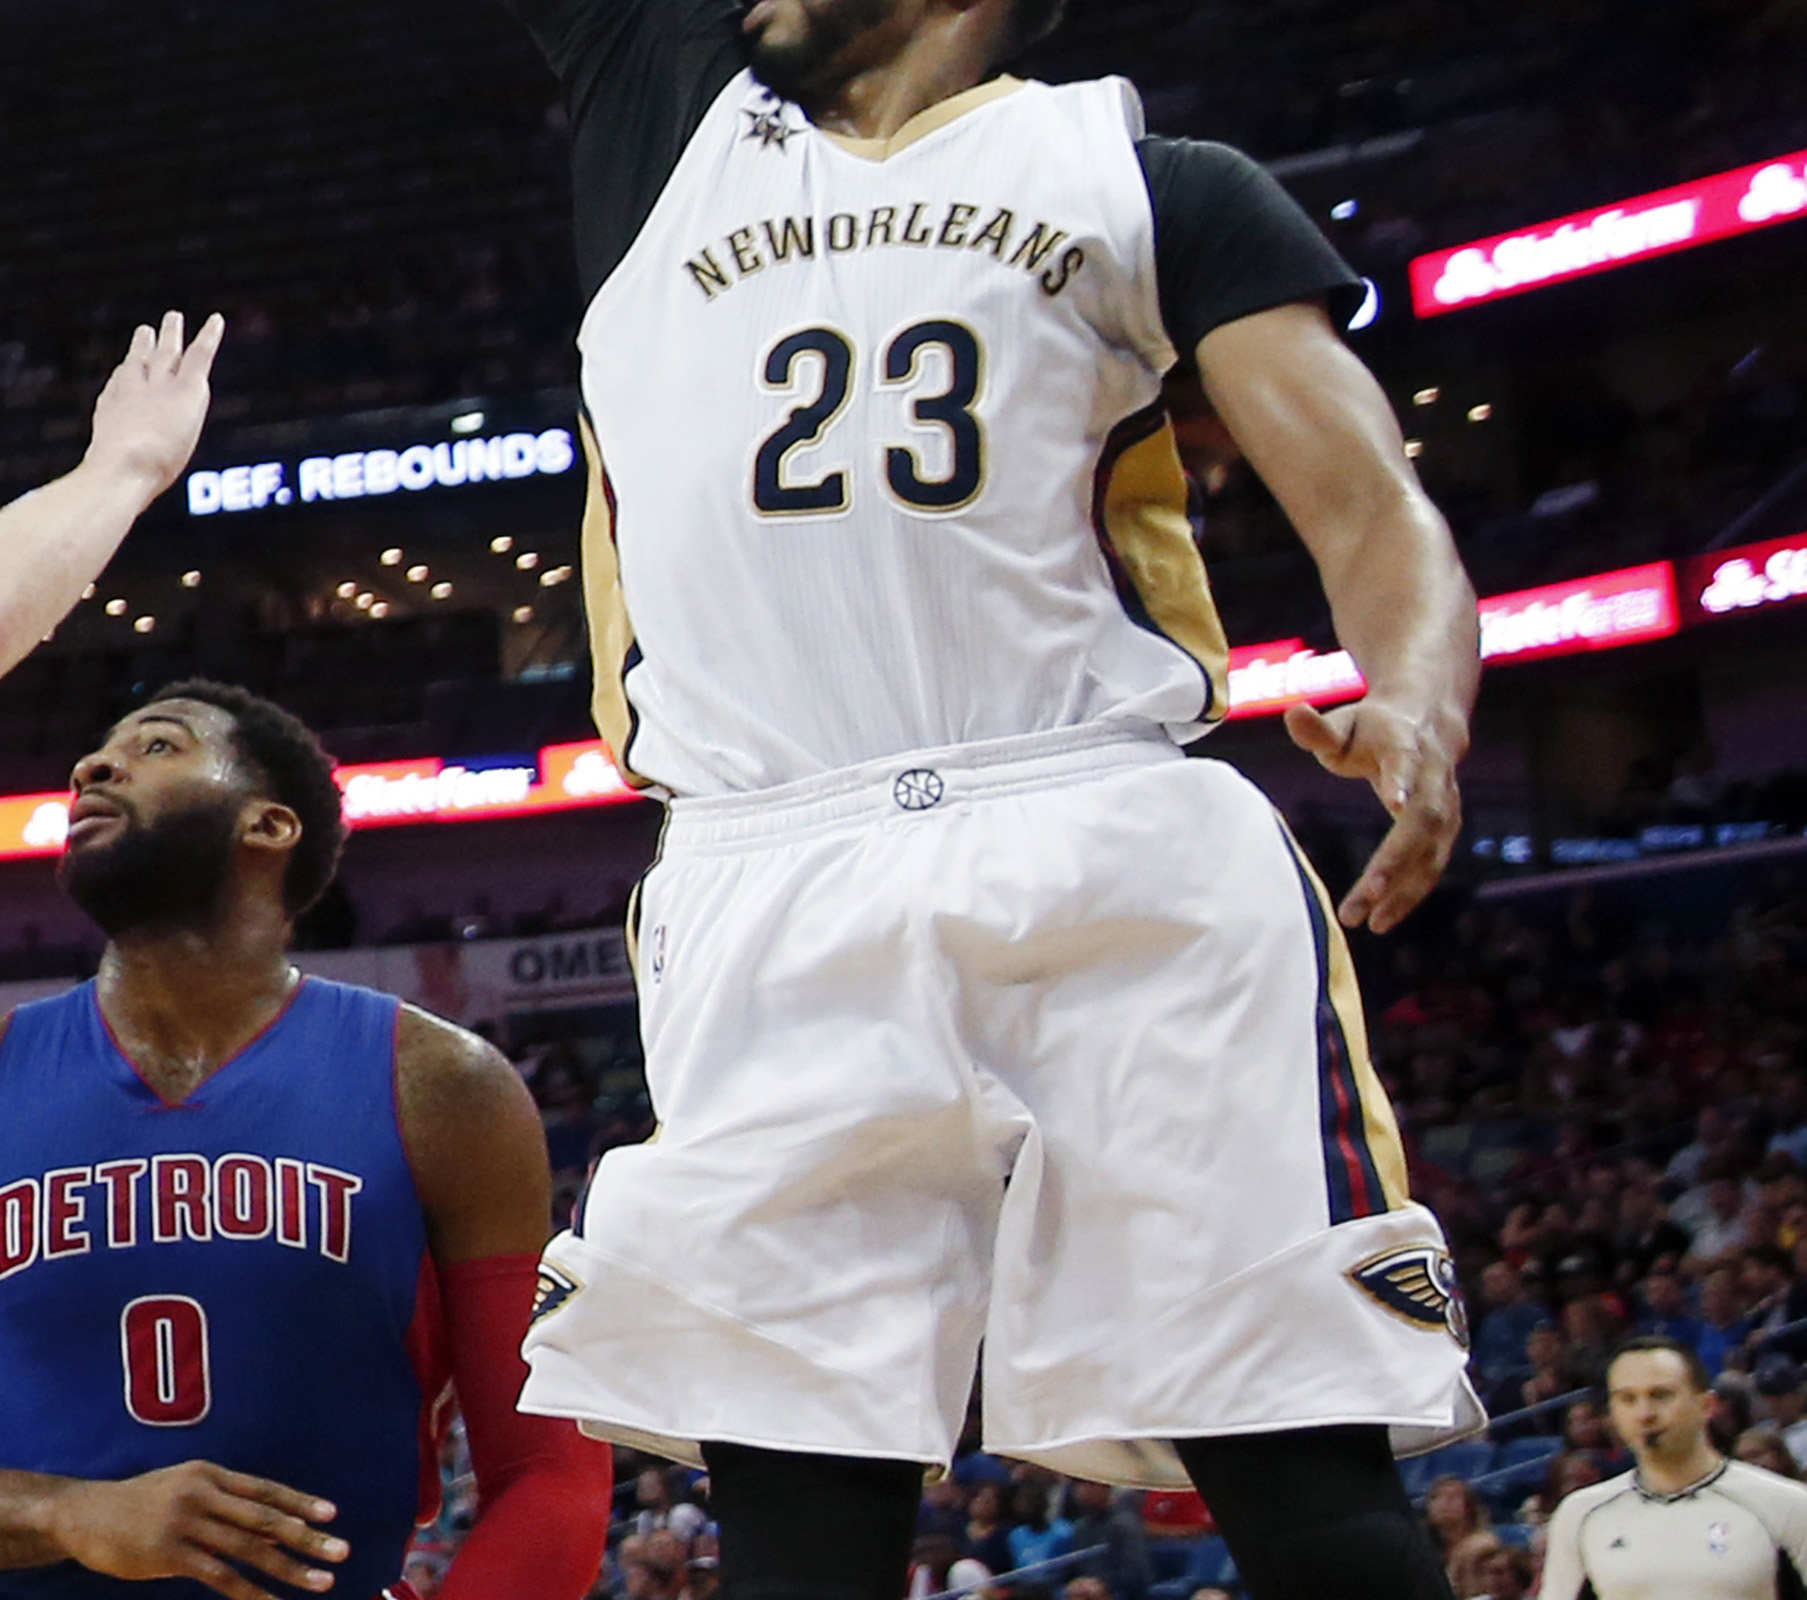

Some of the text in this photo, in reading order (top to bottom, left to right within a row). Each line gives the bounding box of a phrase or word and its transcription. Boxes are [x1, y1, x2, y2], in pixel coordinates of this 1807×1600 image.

[187, 427, 575, 516] DEF. REBOUNDS
[751, 316, 989, 517] 23
[120, 1294, 213, 1428] 0
